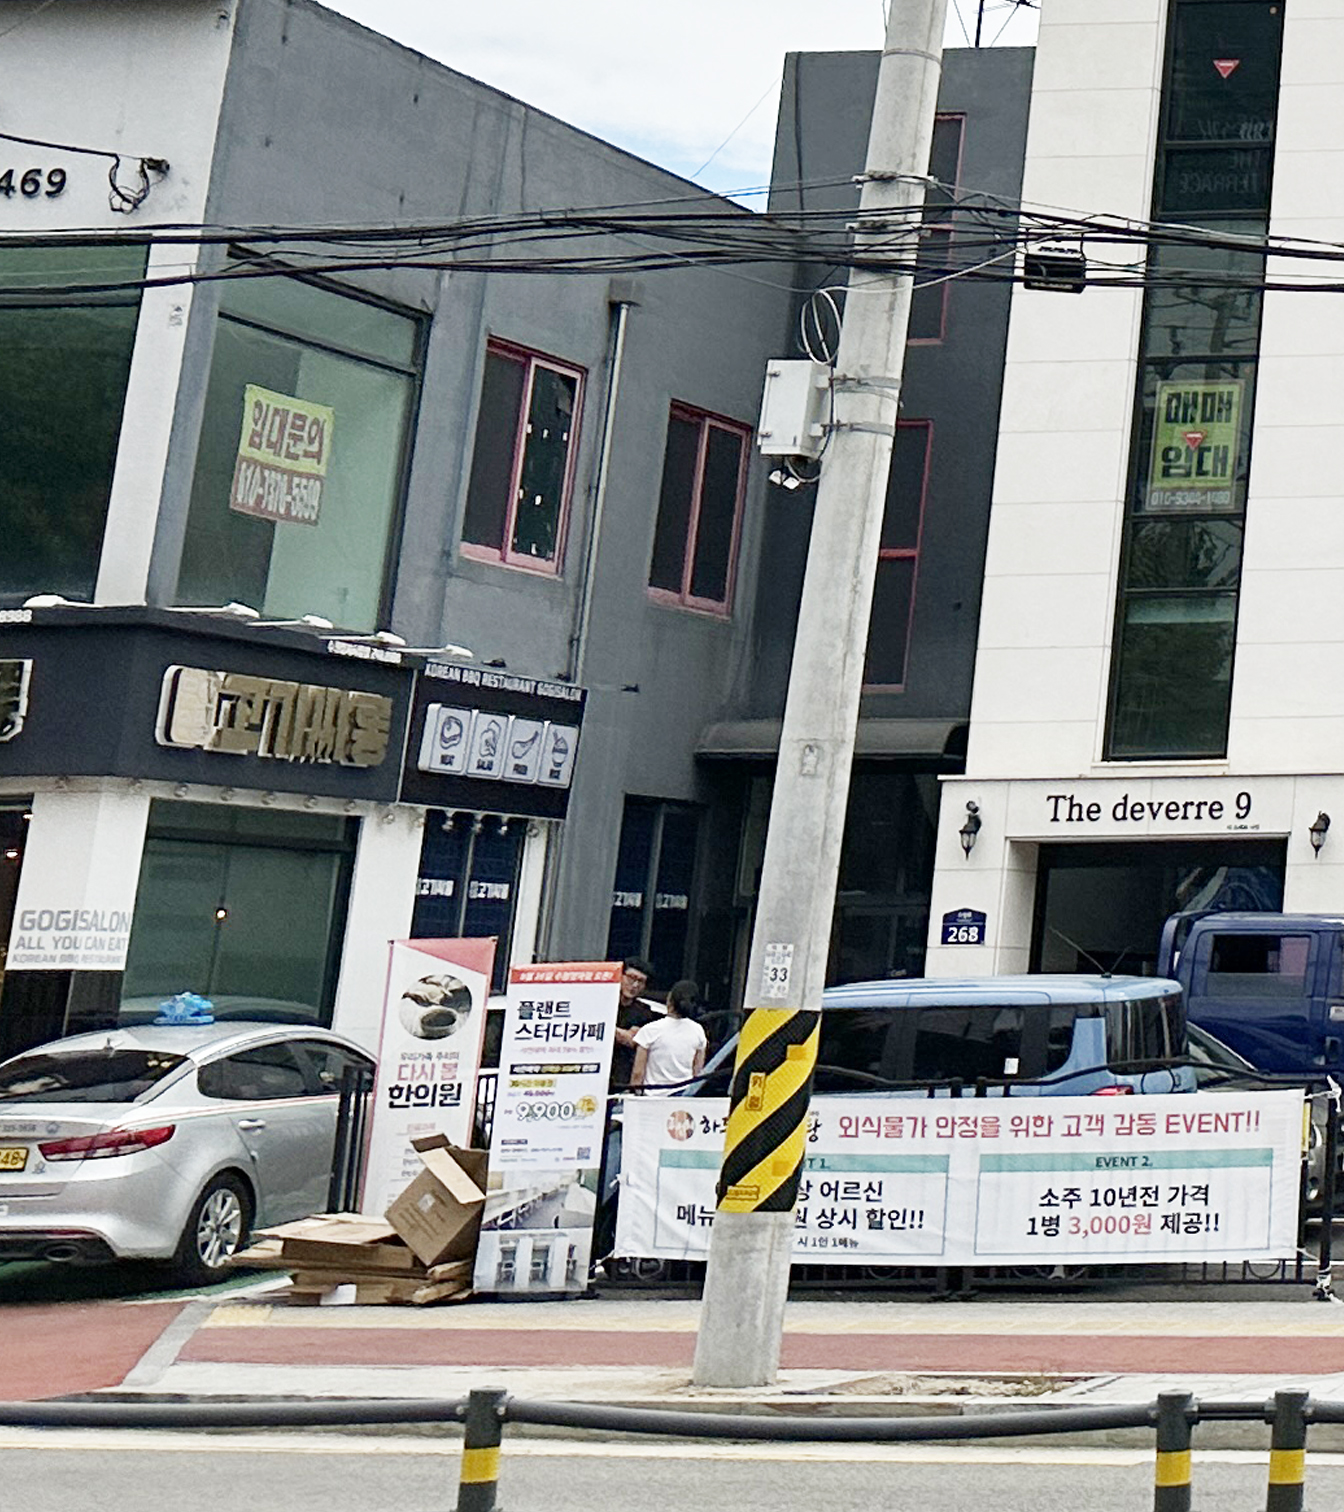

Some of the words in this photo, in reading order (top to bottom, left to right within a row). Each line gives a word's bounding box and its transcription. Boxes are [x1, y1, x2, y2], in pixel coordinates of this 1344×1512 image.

[1165, 391, 1234, 424] 매매
[248, 399, 327, 465] 임대문의
[1161, 445, 1230, 478] 임대
[1045, 794, 1102, 822] The
[1111, 793, 1224, 822] deverre
[1235, 791, 1252, 820] 9
[15, 935, 47, 951] ALL
[52, 935, 83, 951] YOU
[107, 937, 129, 952] EAT
[947, 925, 980, 943] 268
[769, 967, 789, 983] 33
[517, 1000, 572, 1021] 플랜트
[514, 1021, 606, 1043] 스터디카페
[396, 1062, 436, 1082] 다시
[388, 1082, 463, 1109] 한의원
[838, 1115, 928, 1139] 외식물가
[935, 1114, 1002, 1139] 안정을
[1009, 1114, 1054, 1138] 위한
[1061, 1113, 1106, 1137] 고객
[1113, 1112, 1158, 1136] 감동
[1165, 1110, 1261, 1135] EVENT!!
[1095, 1156, 1138, 1169] EVENT
[820, 1180, 884, 1202] 어르신
[1038, 1187, 1083, 1209] 소주
[1090, 1185, 1160, 1208] 10년전
[1168, 1184, 1210, 1207] 가격
[815, 1207, 858, 1231] 상시
[866, 1207, 925, 1231] 할인!!
[1026, 1215, 1061, 1237] 1병
[1068, 1212, 1152, 1239] 3,000원
[1160, 1212, 1220, 1235] 제공!!
